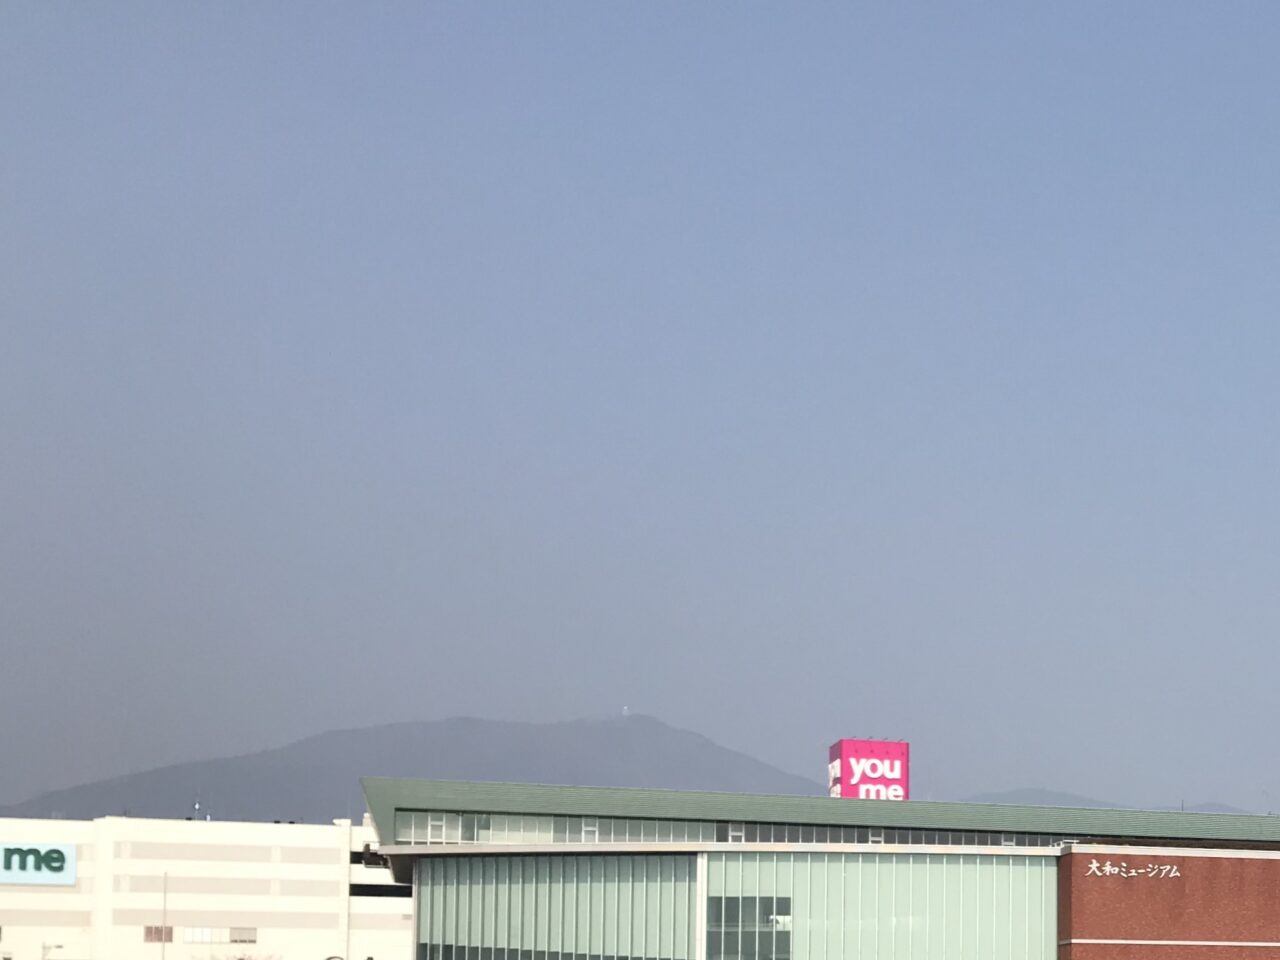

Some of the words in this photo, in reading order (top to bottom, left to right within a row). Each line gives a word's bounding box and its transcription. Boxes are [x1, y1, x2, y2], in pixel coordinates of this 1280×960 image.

[849, 757, 901, 785] you
[859, 783, 904, 800] me
[3, 847, 65, 872] me
[1084, 858, 1181, 878] 大和ミュージアム
